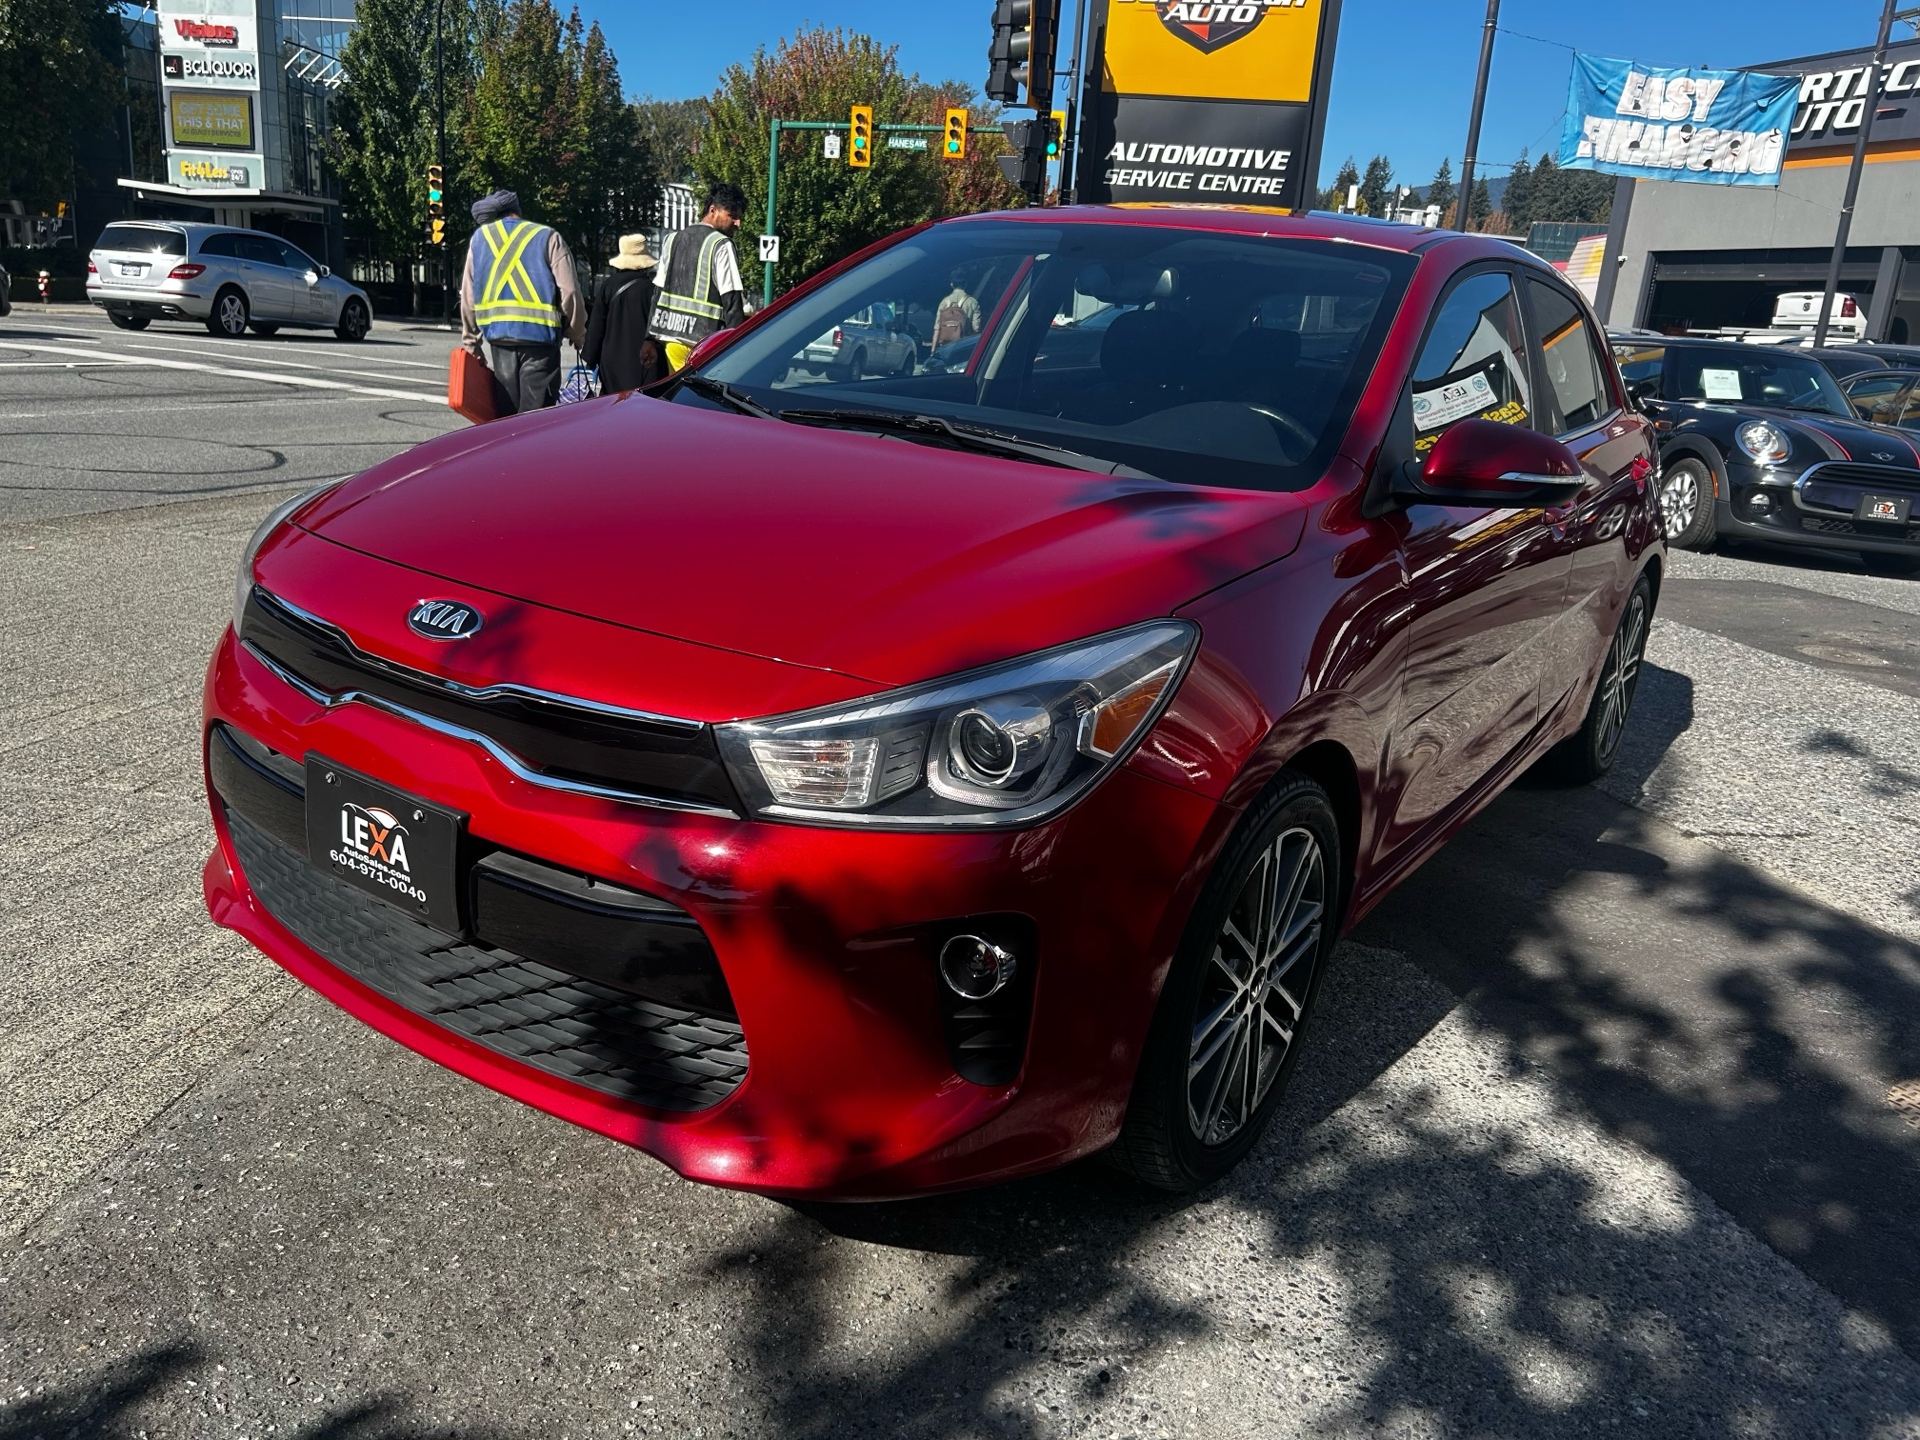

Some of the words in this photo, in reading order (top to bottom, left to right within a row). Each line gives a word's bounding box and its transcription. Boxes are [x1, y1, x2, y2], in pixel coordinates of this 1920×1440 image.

[1163, 4, 1258, 23] AUTO
[178, 102, 203, 114] GIFT
[206, 103, 241, 117] SOME
[1616, 70, 1726, 122] EASY
[177, 115, 203, 128] THIS
[205, 117, 213, 128] &
[215, 118, 244, 130] THAT
[889, 137, 914, 148] HANES
[1104, 142, 1291, 170] AUTOMOTIVE
[1103, 168, 1194, 189] SERVICE
[1198, 173, 1286, 195] CENTRE
[650, 308, 697, 334] ECURITY
[412, 601, 470, 634] KIA
[341, 809, 411, 872] LEXA
[330, 849, 427, 902] 604-971-0040
[342, 846, 411, 883] AutoSales.com
